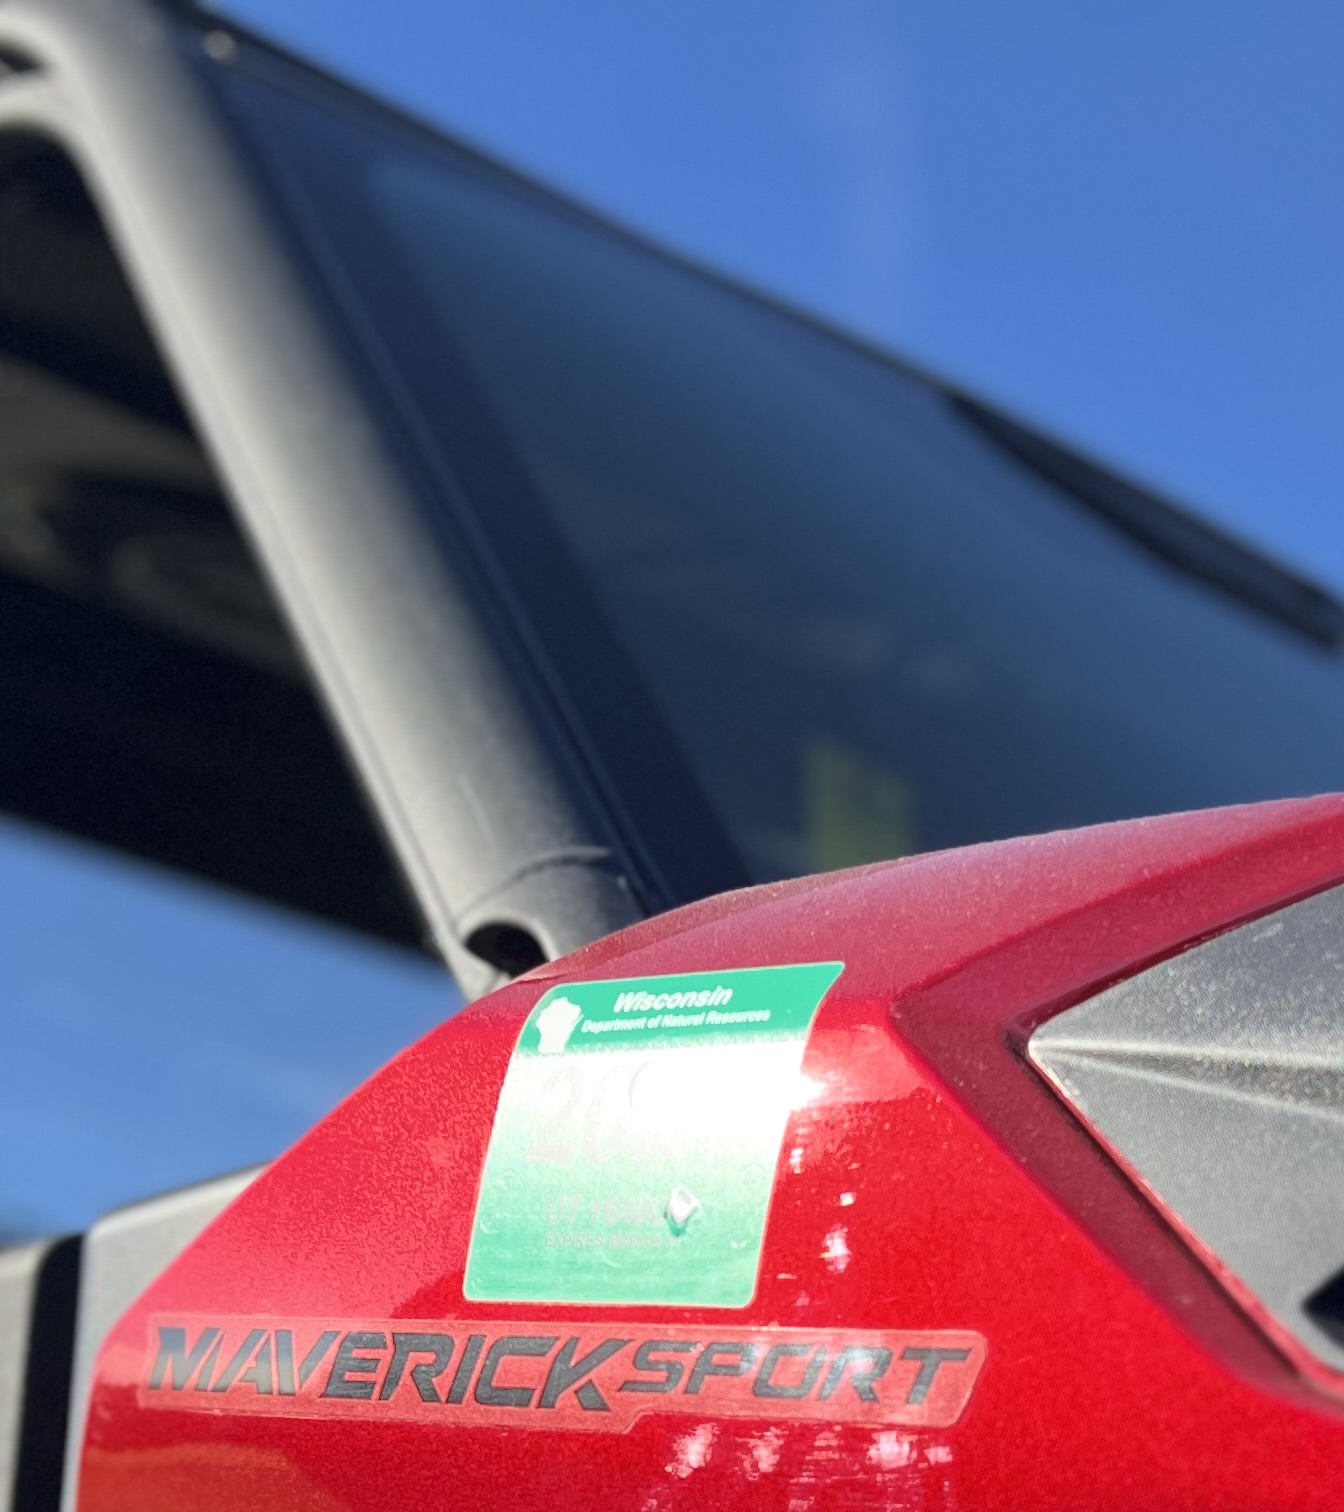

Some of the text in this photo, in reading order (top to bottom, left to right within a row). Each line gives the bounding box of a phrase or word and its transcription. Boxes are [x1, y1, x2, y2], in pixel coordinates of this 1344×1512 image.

[613, 985, 734, 1013] Wisconsin
[580, 1009, 771, 1035] Department of Natural Resources
[146, 1326, 975, 1413] MAVERICK SPORT
